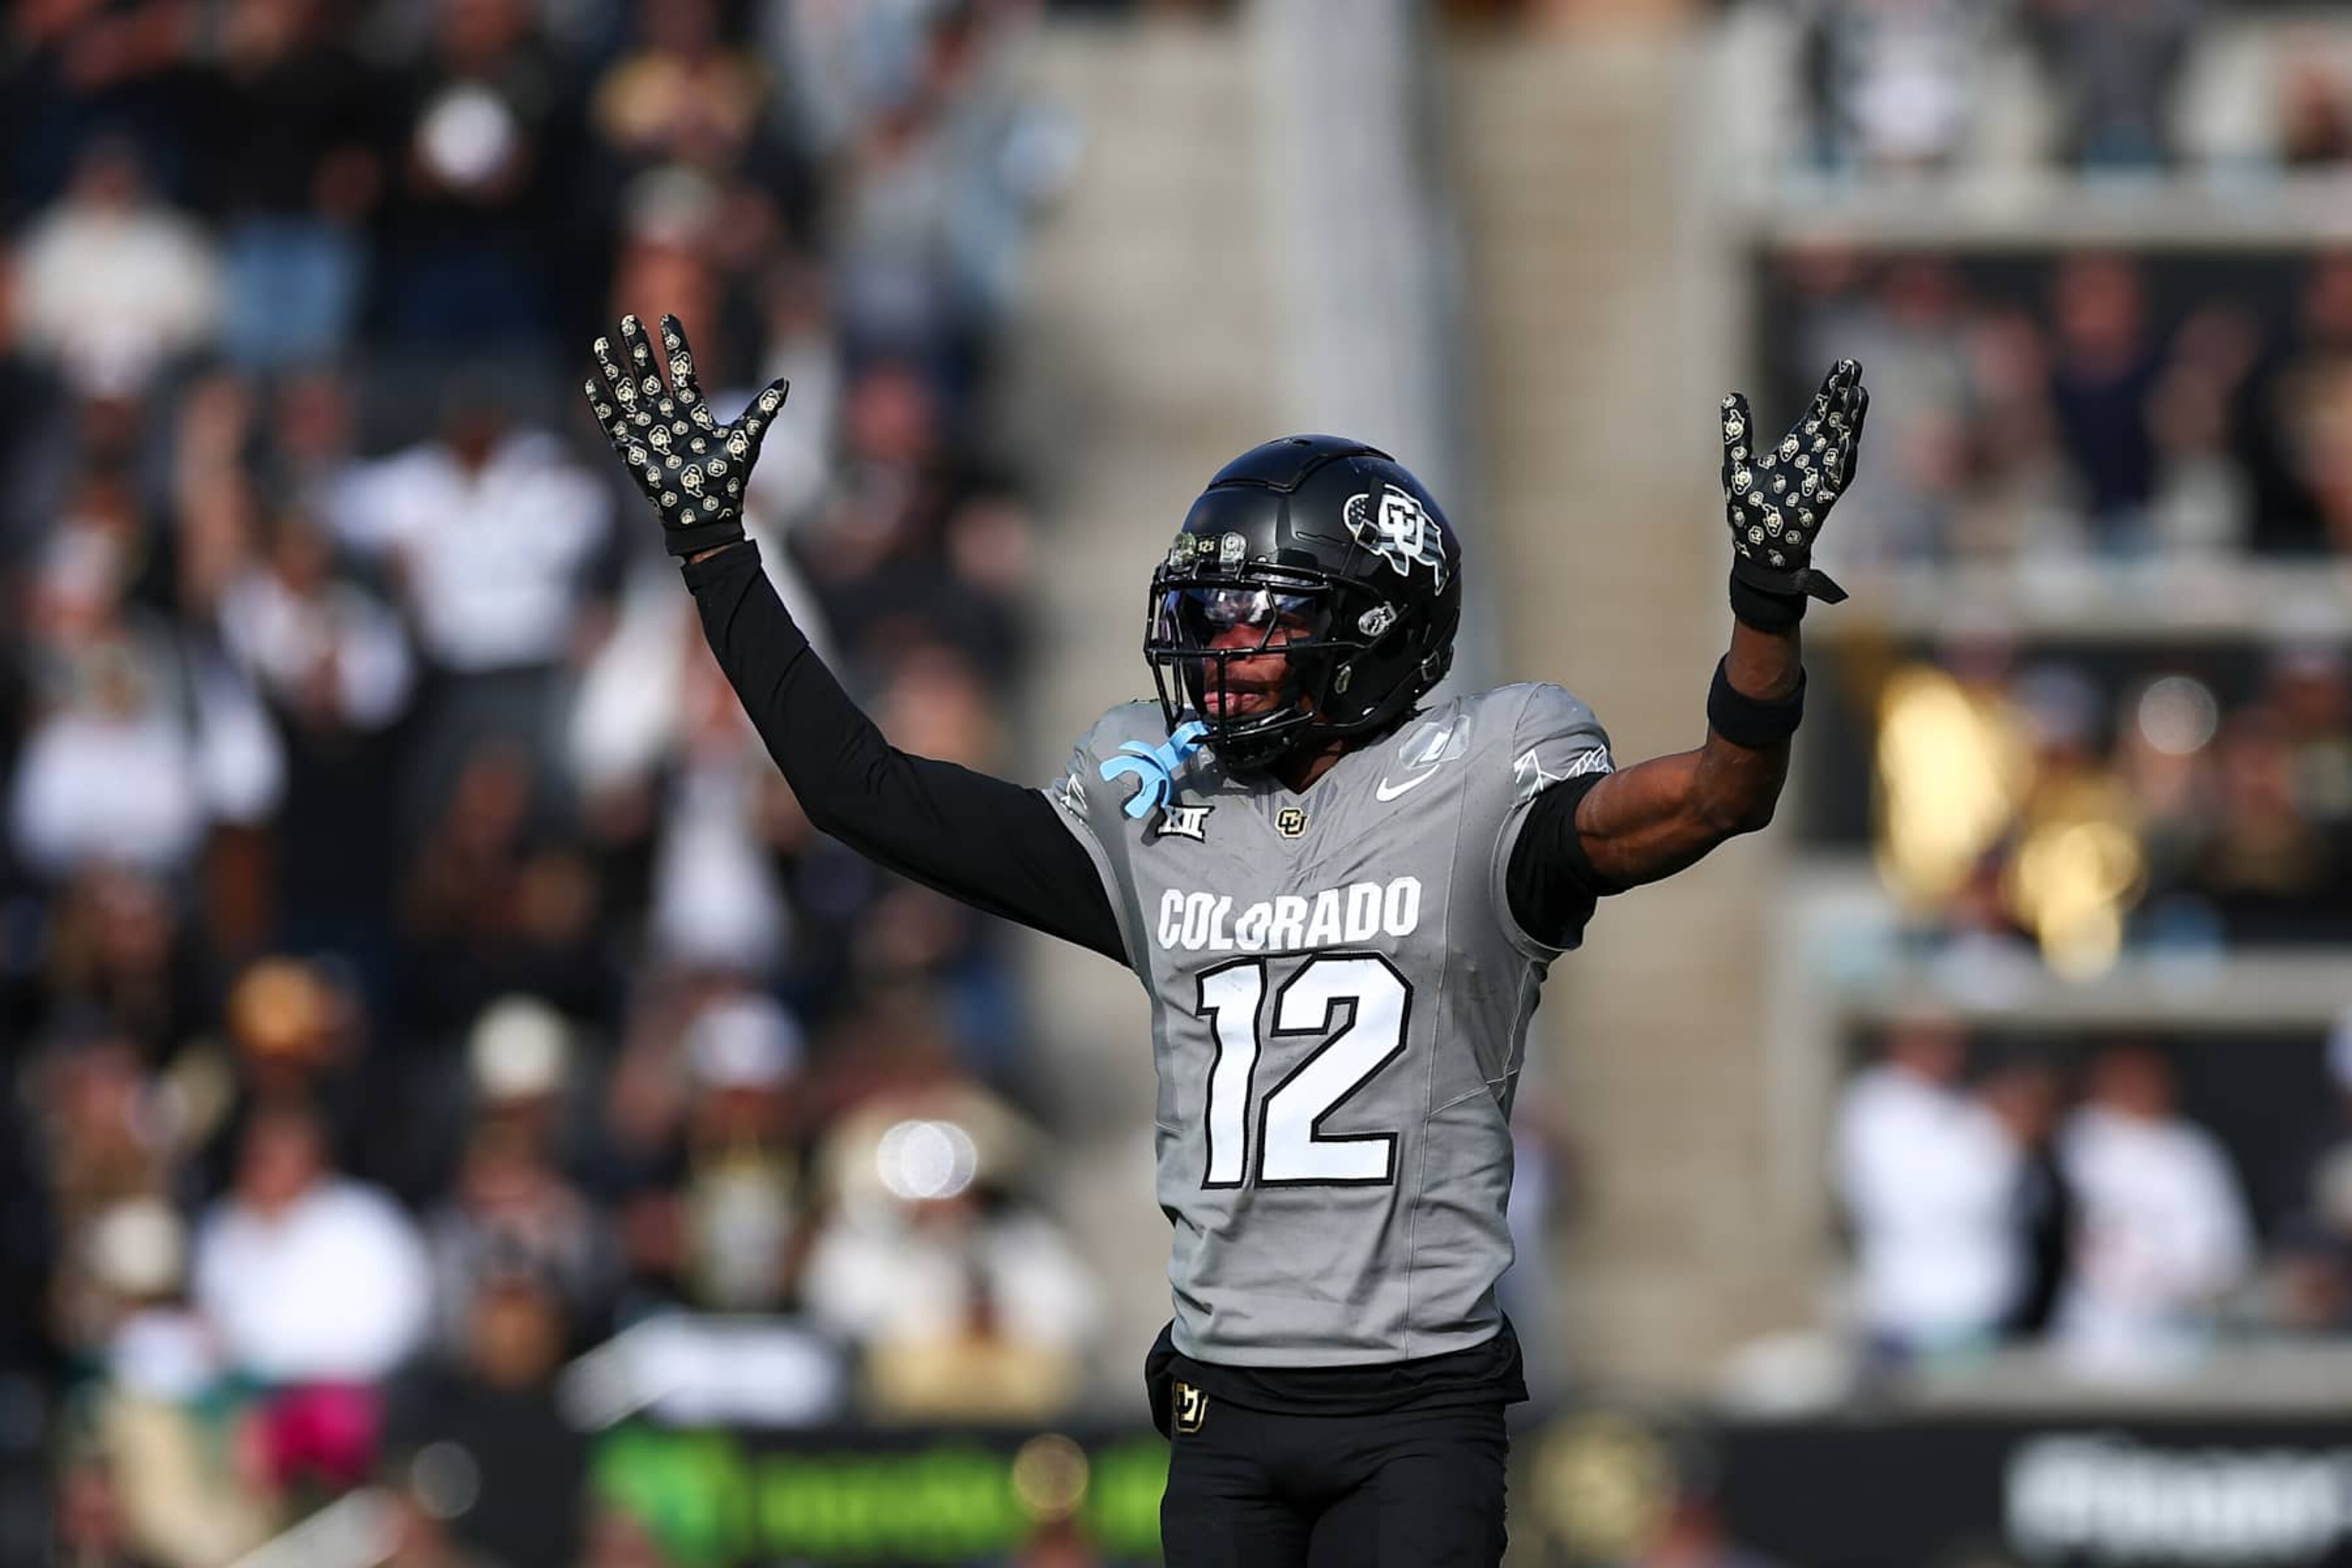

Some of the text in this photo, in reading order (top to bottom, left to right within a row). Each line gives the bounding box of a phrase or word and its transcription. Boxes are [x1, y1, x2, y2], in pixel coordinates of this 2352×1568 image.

[1157, 806, 1213, 842] XII
[1276, 808, 1309, 838] CU
[1158, 875, 1422, 951] COLORADO
[1196, 952, 1414, 1190] 12
